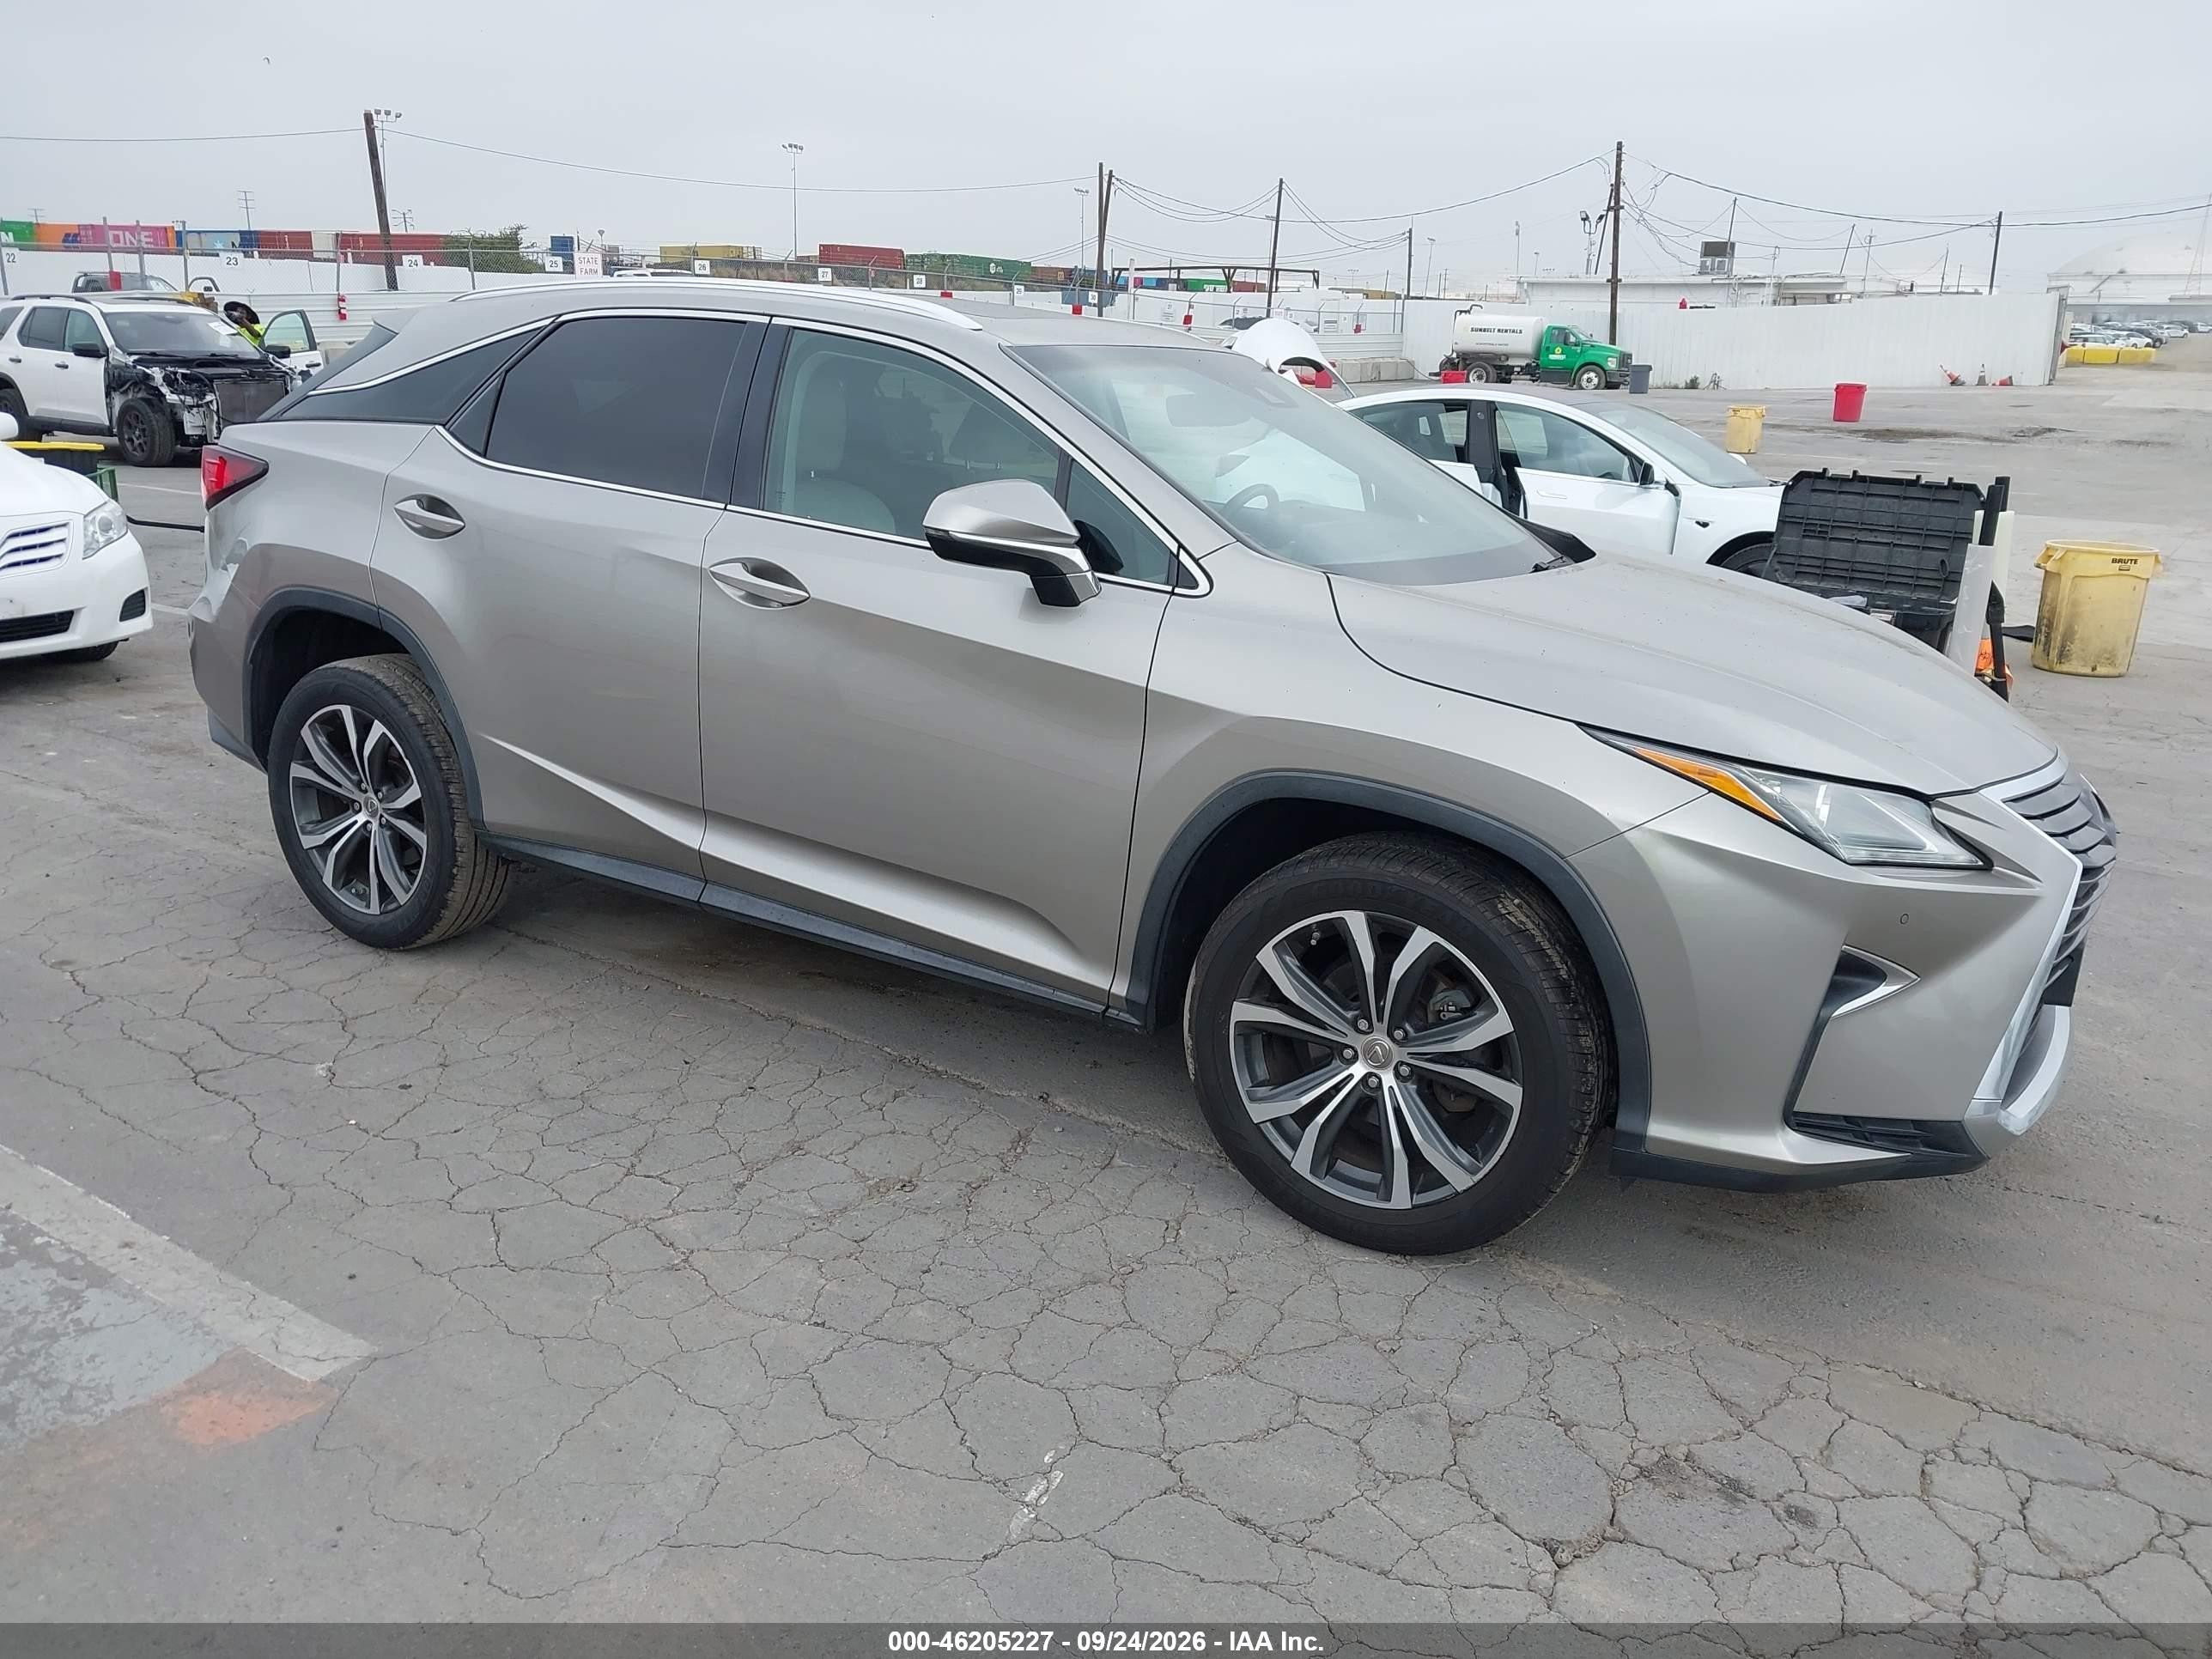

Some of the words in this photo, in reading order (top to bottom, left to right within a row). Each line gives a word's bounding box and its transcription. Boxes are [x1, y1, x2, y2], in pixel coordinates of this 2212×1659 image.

[108, 231, 153, 247] ONE
[6, 252, 16, 263] 22
[226, 256, 239, 266] 23
[578, 257, 599, 265] STATE
[407, 259, 418, 268] 24
[549, 259, 559, 268] 25
[698, 263, 707, 271] 26
[580, 267, 599, 276] FARM
